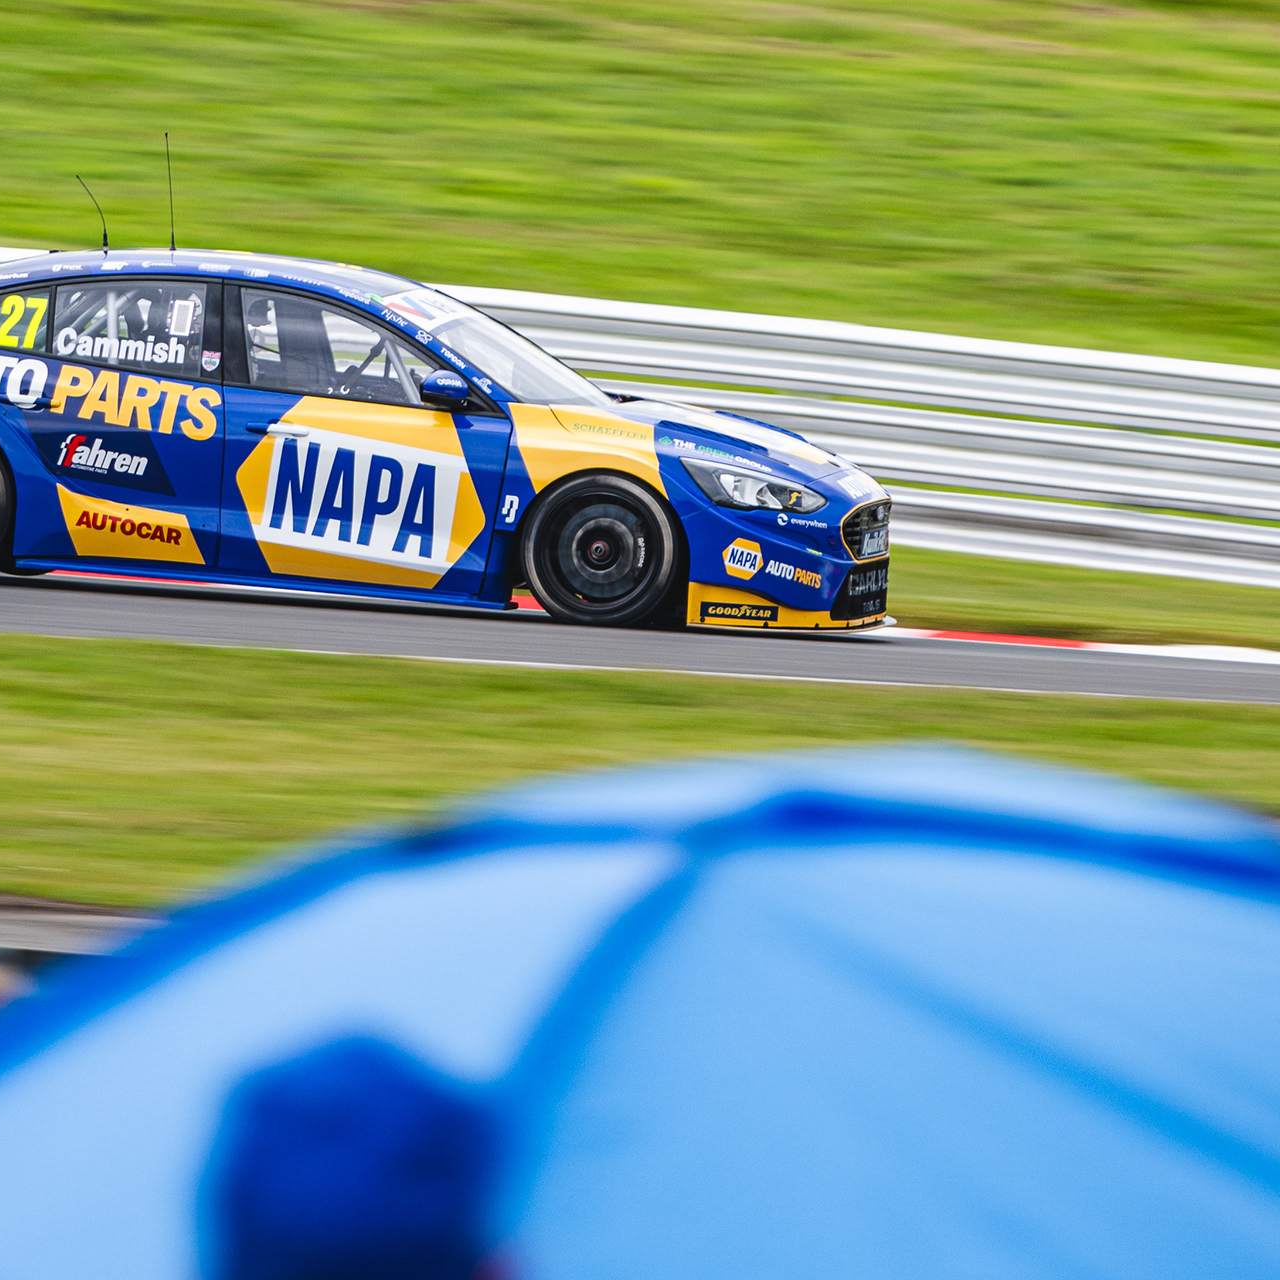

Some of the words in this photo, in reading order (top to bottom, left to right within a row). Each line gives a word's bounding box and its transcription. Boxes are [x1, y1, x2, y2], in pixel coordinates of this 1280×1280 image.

[56, 326, 186, 364] Cammish
[440, 346, 466, 369] TOPDON
[50, 364, 222, 441] PARTS
[572, 422, 647, 440] SCHAEFFLER
[57, 433, 148, 476] fahren
[673, 438, 696, 450] THE
[698, 445, 734, 460] GREEN
[734, 456, 773, 473] GROUP
[269, 437, 436, 559] NAPA
[76, 510, 182, 546] AUTOCAR
[791, 518, 828, 529] everywhen
[728, 547, 758, 571] NAPA
[765, 559, 795, 581] AUTO
[794, 570, 822, 589] PARTS
[848, 569, 888, 596] CARLYL
[708, 605, 772, 618] GOODYEAR
